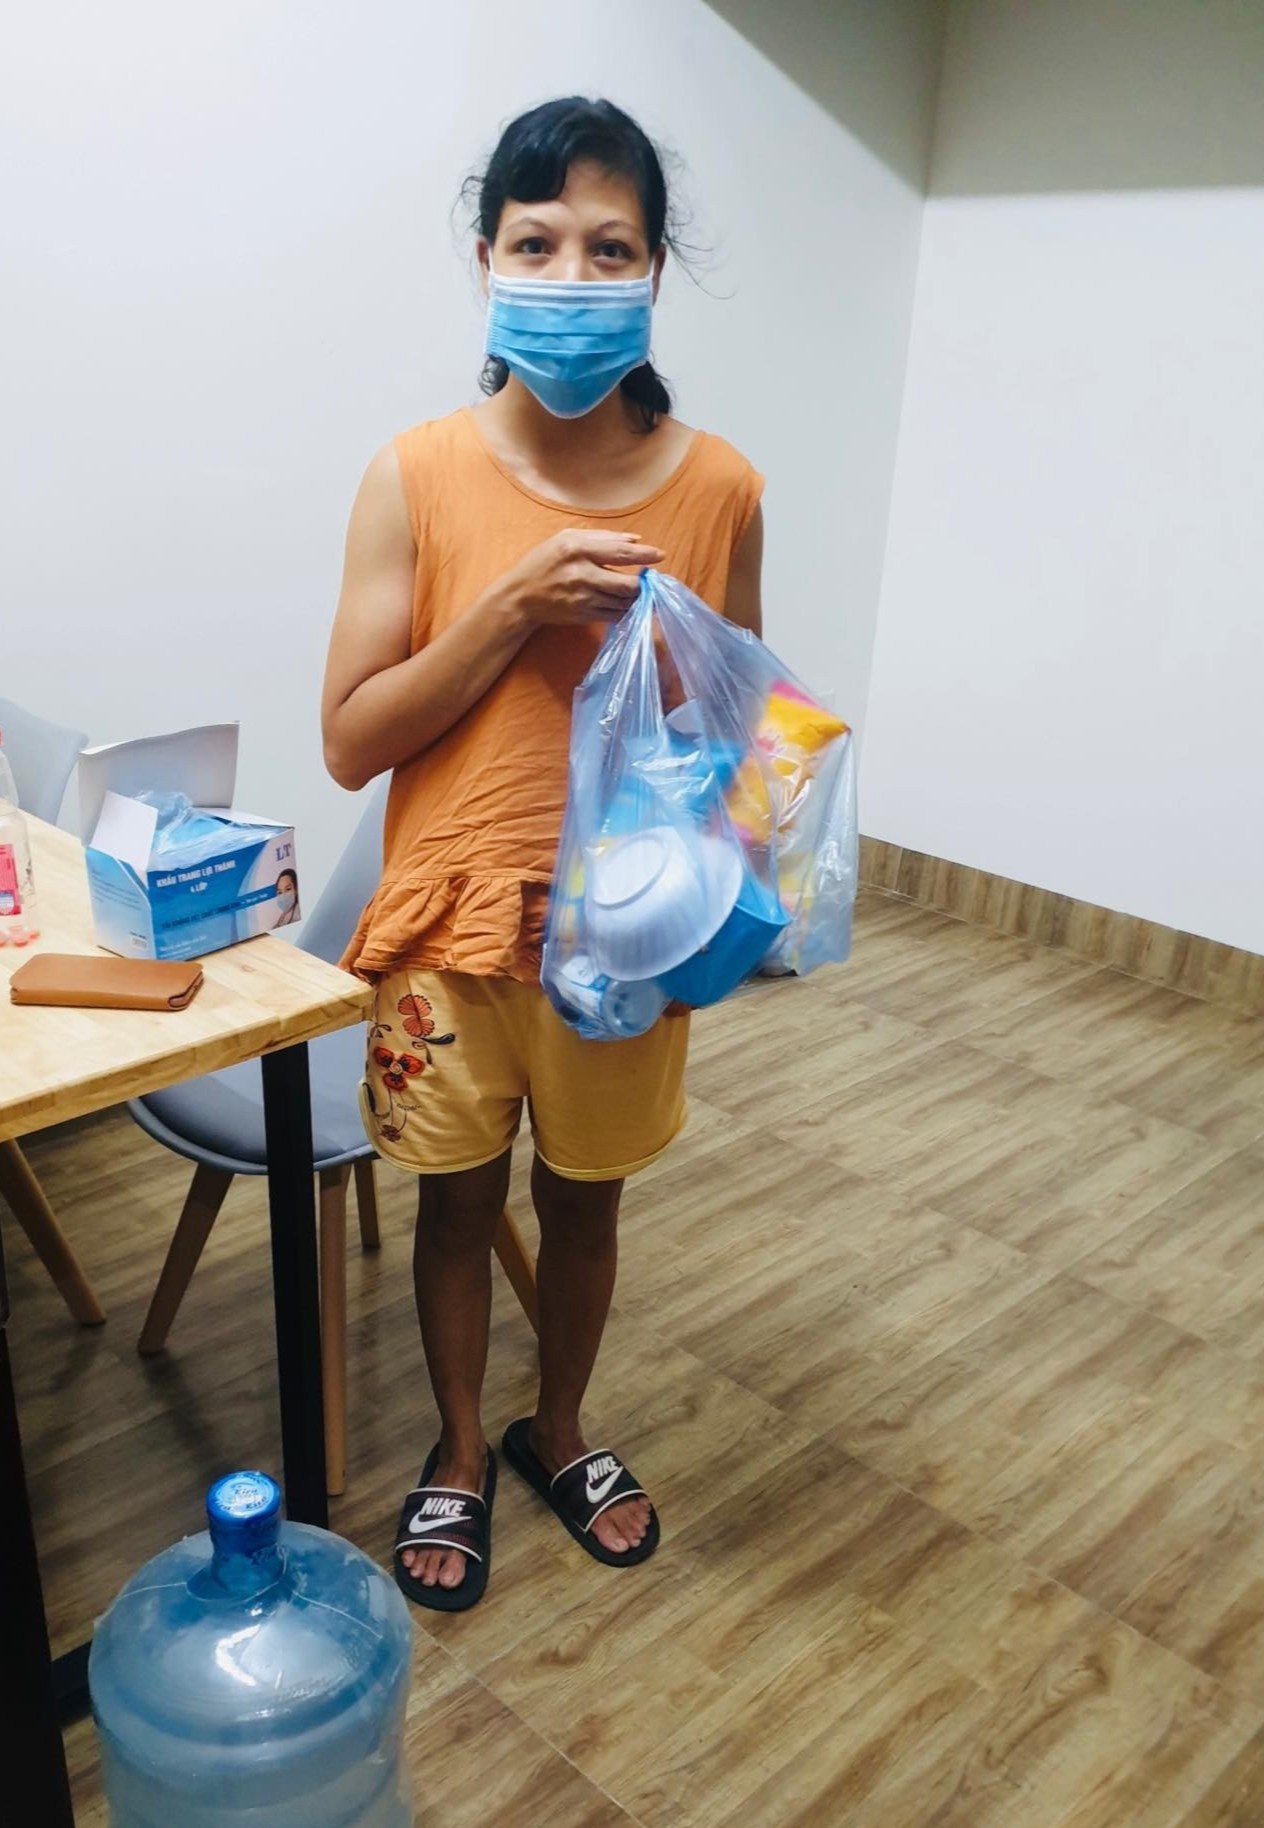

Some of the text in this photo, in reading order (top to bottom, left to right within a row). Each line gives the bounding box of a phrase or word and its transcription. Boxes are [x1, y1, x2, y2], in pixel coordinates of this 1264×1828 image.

[275, 843, 292, 861] LT
[178, 869, 202, 882] TRANG
[586, 1455, 623, 1483] NIKE
[420, 1497, 467, 1517] NIKE
